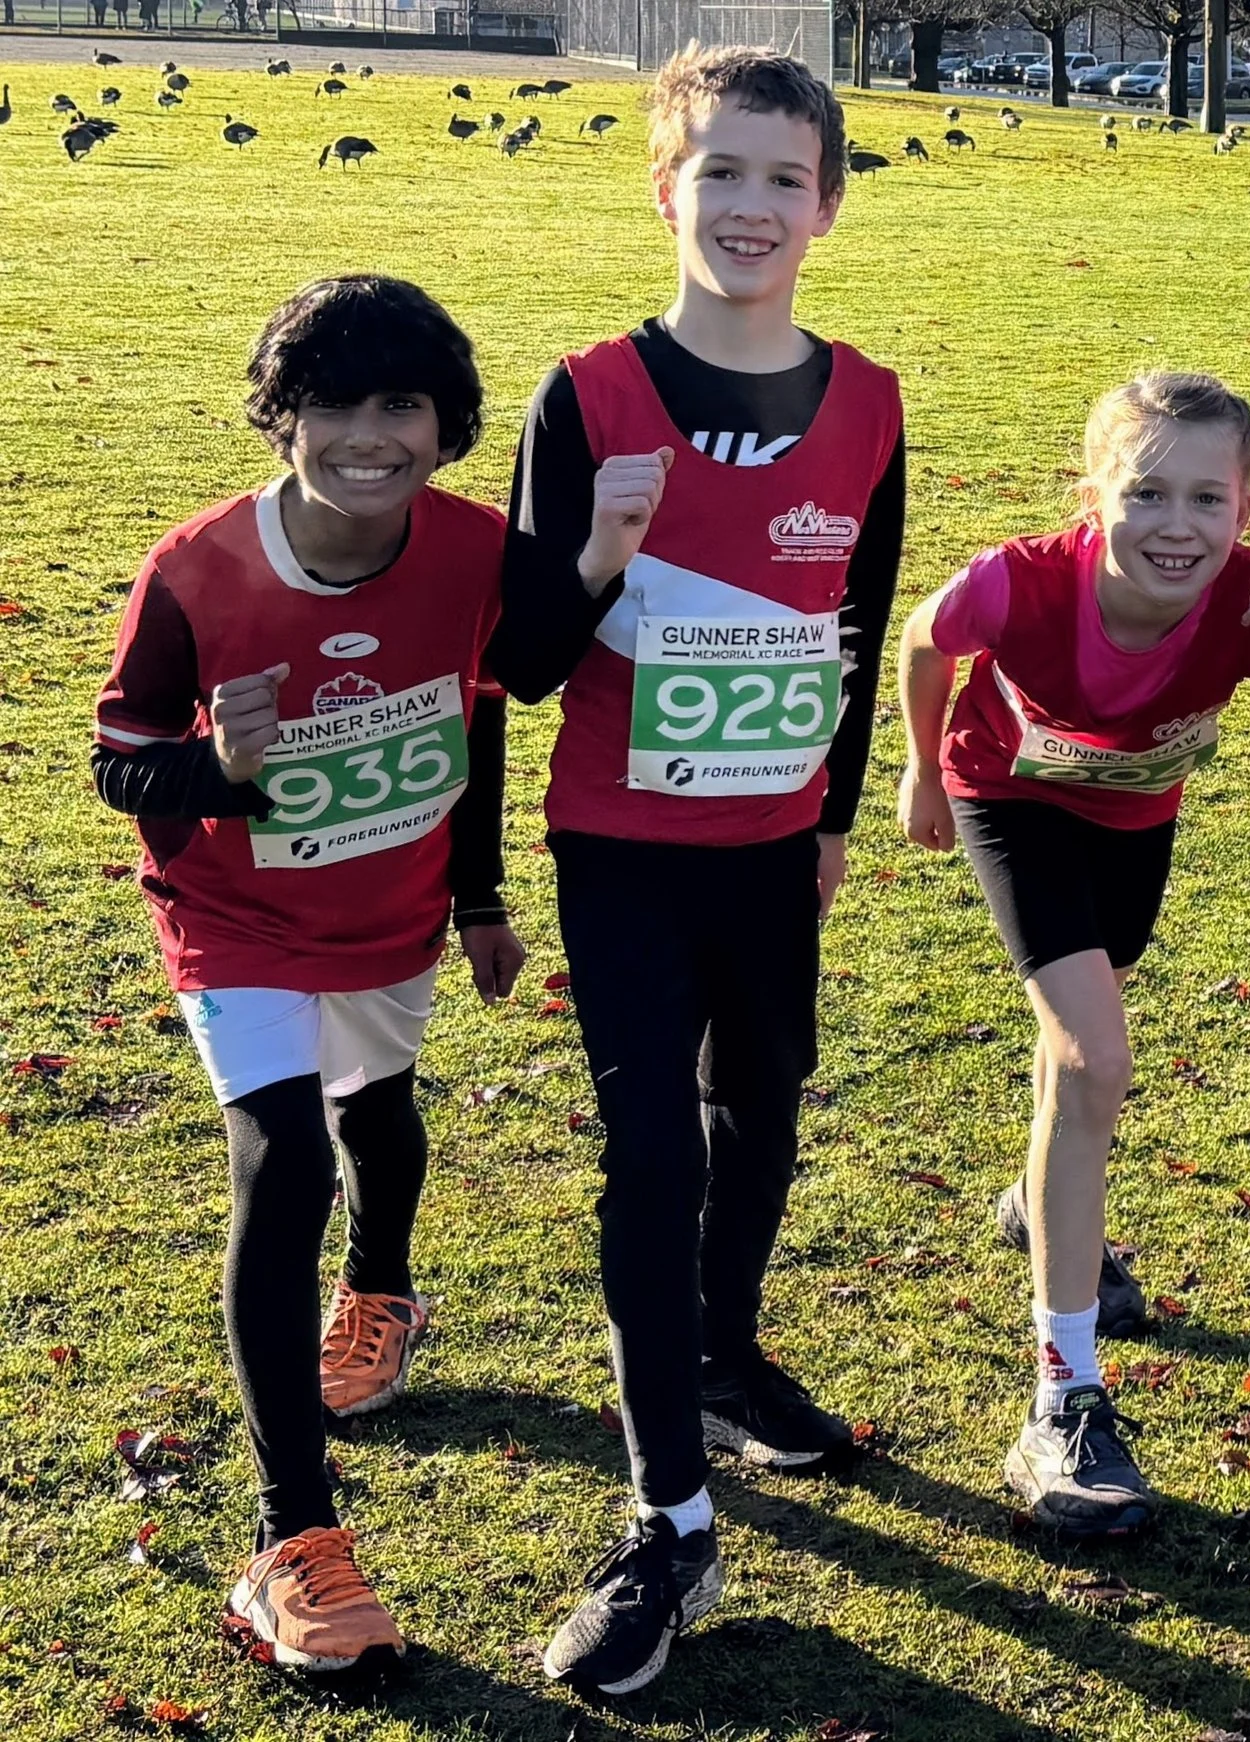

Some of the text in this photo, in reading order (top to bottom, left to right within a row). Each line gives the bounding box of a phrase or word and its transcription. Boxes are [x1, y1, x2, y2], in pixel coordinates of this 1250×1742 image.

[662, 624, 825, 645] GUNNER SHAW
[692, 648, 802, 659] MEMORIAL XC RACE
[276, 688, 440, 744] UNNER SHAW
[655, 671, 824, 741] 925
[296, 717, 414, 755] MEMORIAL XC RACE
[1043, 739, 1134, 762] GUNNER
[267, 729, 451, 824] 935
[702, 762, 807, 778] FORERUNNERS
[327, 808, 440, 848] FORERUNNERS
